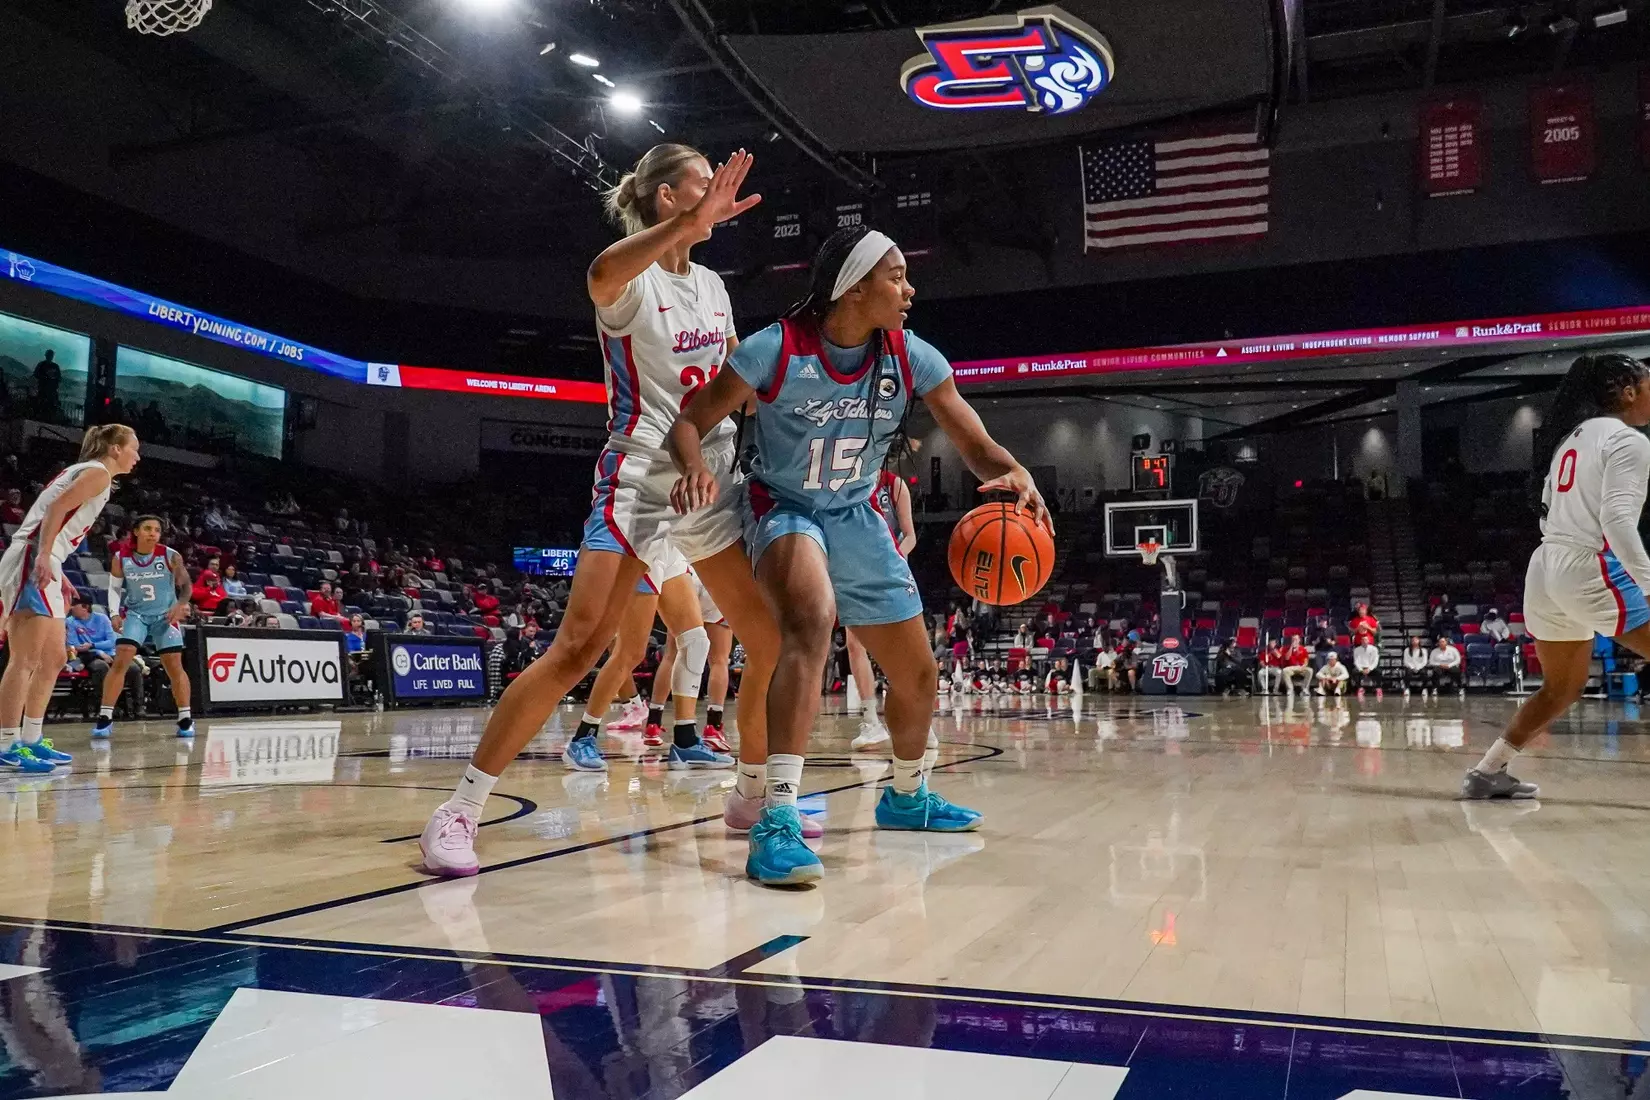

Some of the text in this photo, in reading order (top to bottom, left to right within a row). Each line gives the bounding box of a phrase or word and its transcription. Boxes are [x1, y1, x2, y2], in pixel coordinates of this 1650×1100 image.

[1543, 126, 1580, 144] 2005
[837, 213, 862, 228] 2019
[774, 223, 800, 238] 2023
[1472, 322, 1542, 337] Runk&Pratt
[1585, 317, 1617, 328] LIVING
[672, 327, 725, 355] Liberty
[1241, 331, 1440, 354] ASSISTED LIVING INDEPENDENT LIVING MEMORY SUPPORT
[278, 342, 304, 361] JOBS
[1031, 359, 1087, 372] Runk&Pratt
[1122, 355, 1148, 365] LIVING
[1151, 350, 1205, 362] COMMUNITIES
[955, 366, 1005, 376] MEMORY SUPPORT
[466, 378, 557, 394] WELCOME TO LIBERTY ARENA
[802, 437, 868, 492] 15
[1557, 448, 1578, 493] 0
[1152, 468, 1164, 486] 7
[542, 549, 580, 558] LIBERTY
[552, 558, 569, 570] 46
[974, 550, 994, 600] ELITE
[140, 584, 156, 602] 3
[413, 652, 450, 671] Carter
[452, 653, 482, 671] Bank
[413, 679, 475, 690] LIFE LIVED FULL
